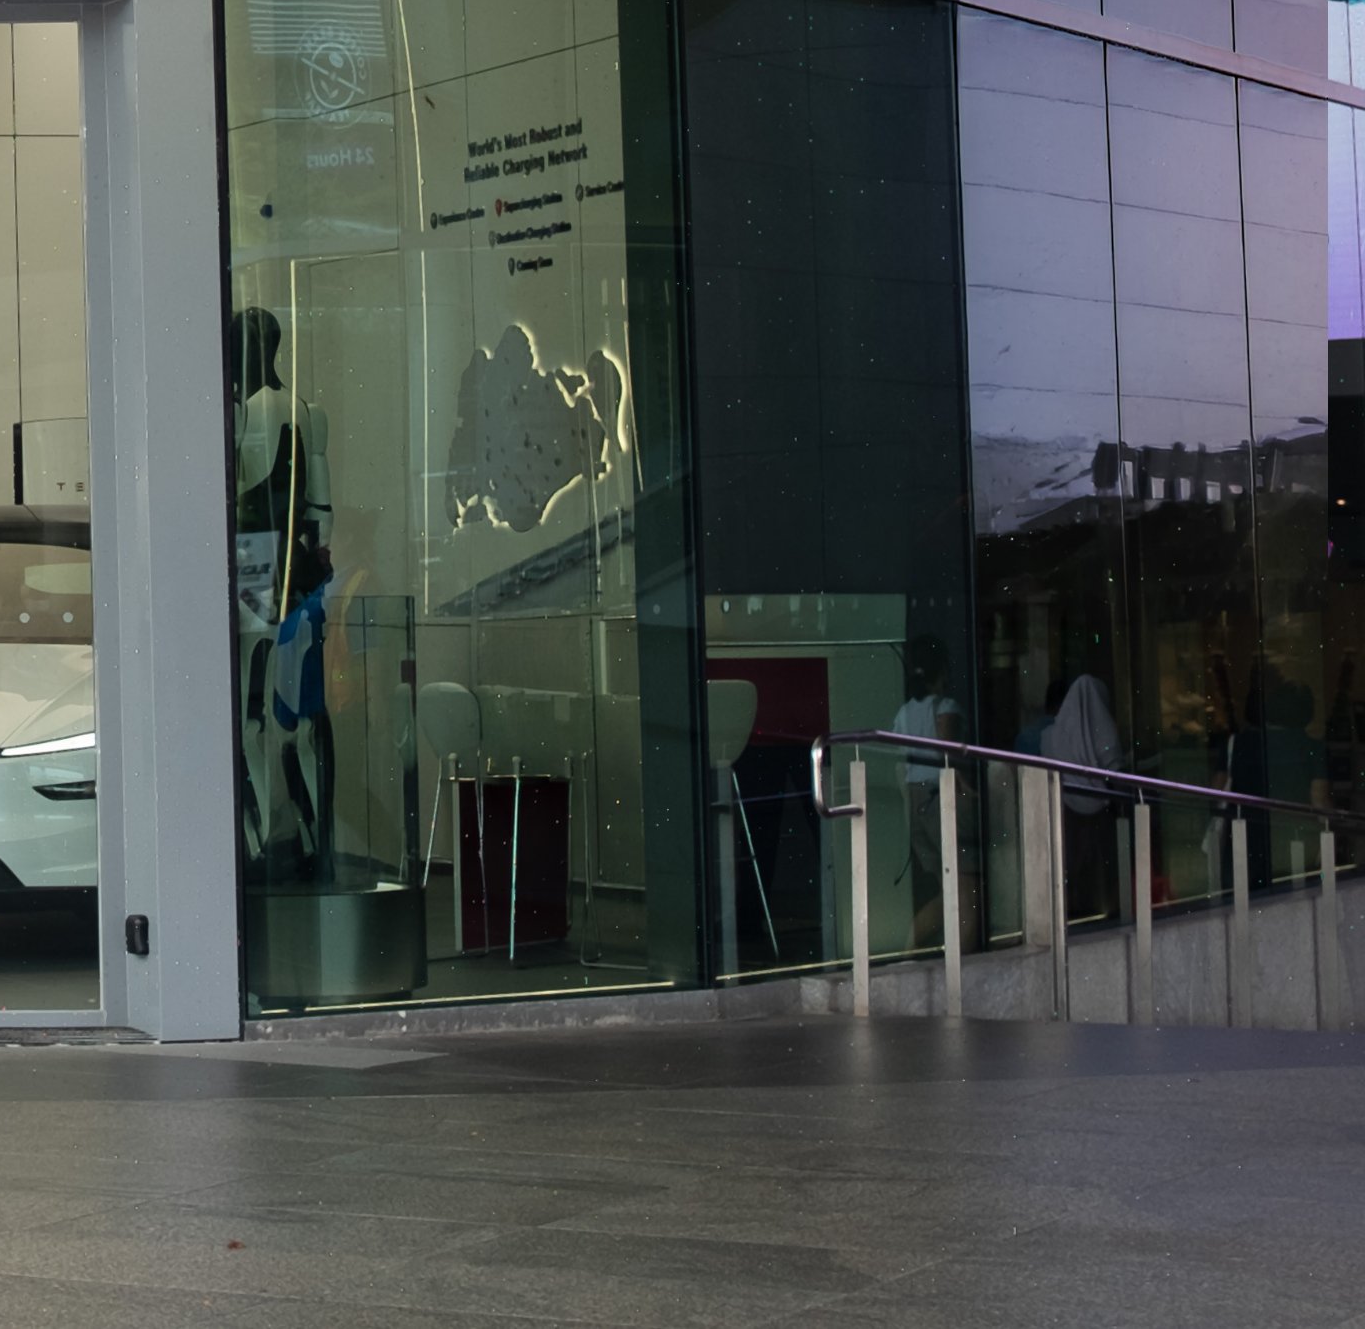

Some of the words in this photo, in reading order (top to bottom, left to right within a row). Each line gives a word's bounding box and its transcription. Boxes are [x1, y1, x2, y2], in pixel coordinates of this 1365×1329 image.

[467, 136, 502, 158] World's
[504, 132, 527, 150] Most
[529, 124, 562, 145] Robust
[564, 117, 583, 138] and
[502, 154, 545, 177] Charging
[547, 142, 588, 167] Network
